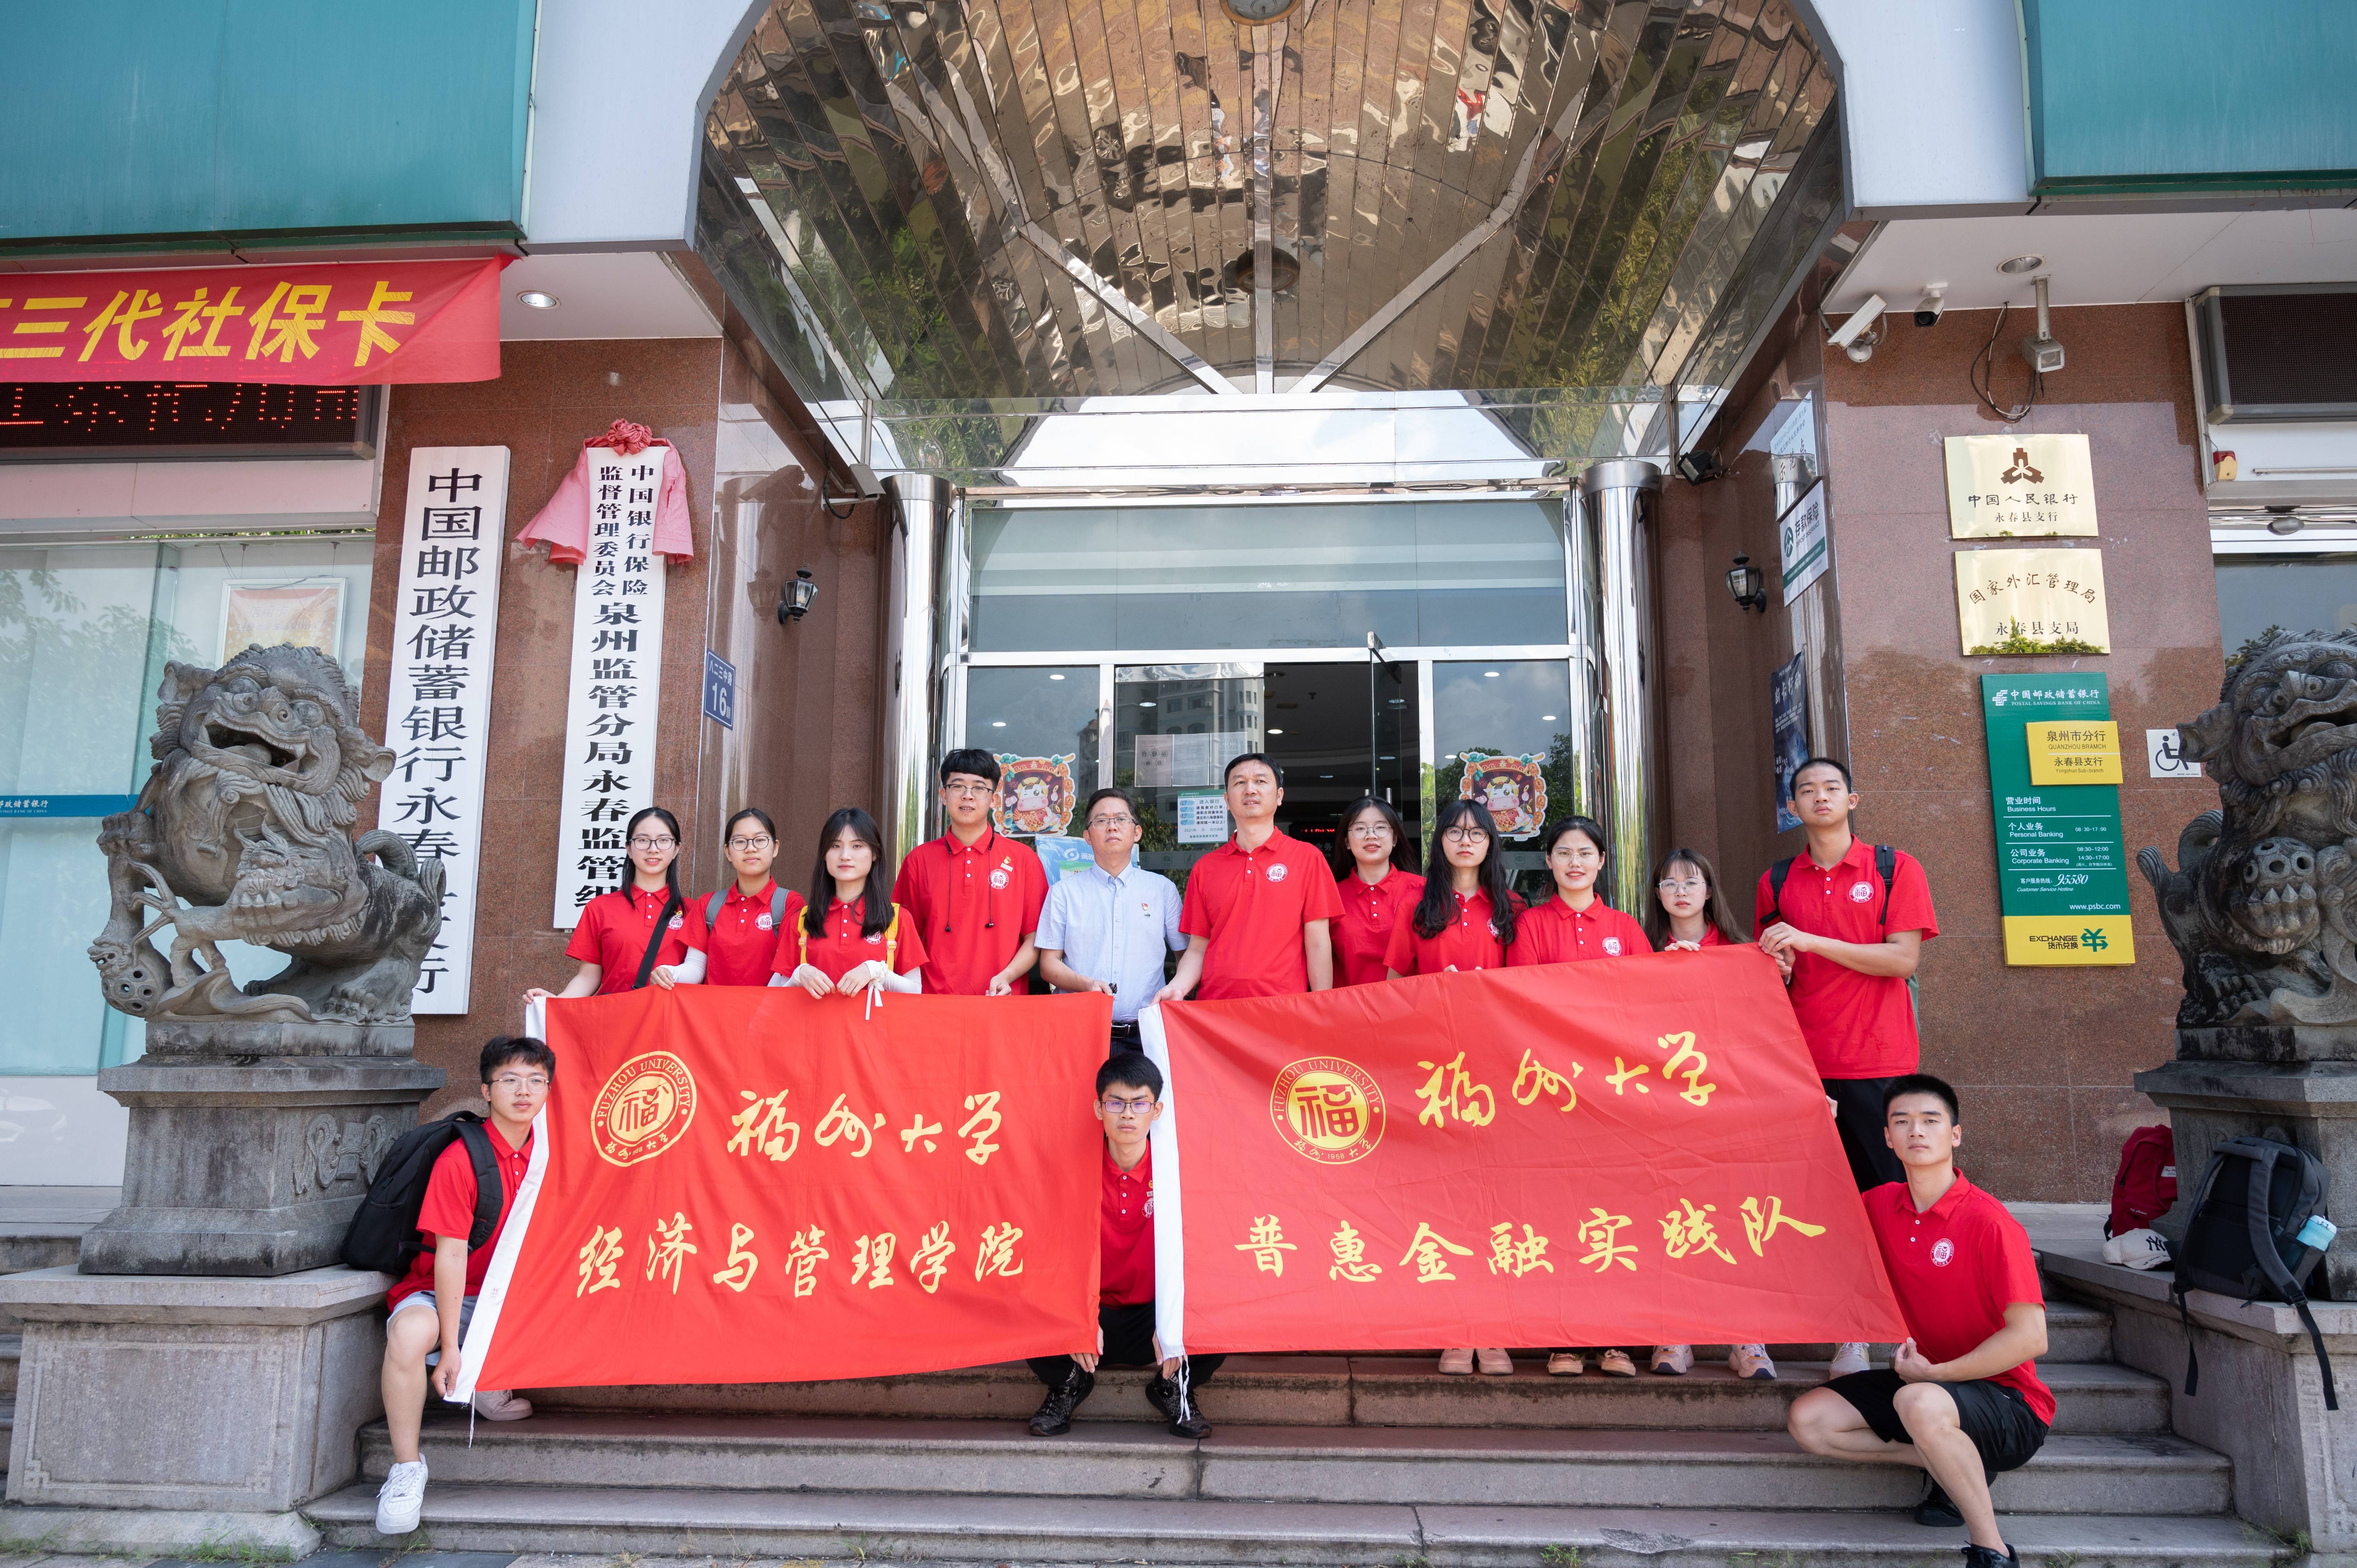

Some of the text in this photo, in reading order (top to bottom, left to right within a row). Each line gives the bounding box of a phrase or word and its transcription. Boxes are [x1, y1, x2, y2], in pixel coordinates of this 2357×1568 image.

[0, 281, 416, 367] 三代社保卡
[1968, 493, 2078, 508] 中国人民银行
[592, 465, 624, 596] 监督管理委员会
[622, 465, 654, 596] 中国银行保险
[1795, 501, 1819, 539] 存款保险
[1994, 512, 2058, 523] 永春县支行
[1796, 520, 1820, 547] DEPOSIT INSURANCE
[1969, 573, 2096, 604] 国家外汇管理局
[248, 605, 289, 618] 信用卡
[1995, 622, 2078, 635] 永春县支局
[709, 660, 733, 686] 八二三中路
[712, 682, 727, 716] 16
[1775, 671, 1801, 705] 断卡行动
[2010, 689, 2099, 701] 中国邮政储蓄银行
[392, 468, 481, 994] 中国邮政储蓄银行永春行
[2047, 730, 2106, 742] 泉州市分行
[1030, 760, 1038, 769] 春
[1498, 759, 1507, 768] 春
[2054, 757, 2103, 766] 永春县支行
[2005, 796, 2041, 805] 营业时间
[2008, 822, 2043, 831] 个人业务
[2010, 848, 2045, 857] 公司业务
[2053, 874, 2088, 886] 95580
[2069, 903, 2121, 911] www.psbc.com
[2048, 941, 2079, 950] 货币兑换
[597, 1058, 691, 1118] FUZHOU UNIVERSITY
[1274, 1060, 1381, 1112] FUZHOU UNIVERSITY
[1415, 1031, 1717, 1128] 福州大学
[727, 1088, 1003, 1166] 福州大学
[1234, 1195, 1828, 1284] 普惠金融实践队
[576, 1211, 1024, 1298] 经济与管理学院
